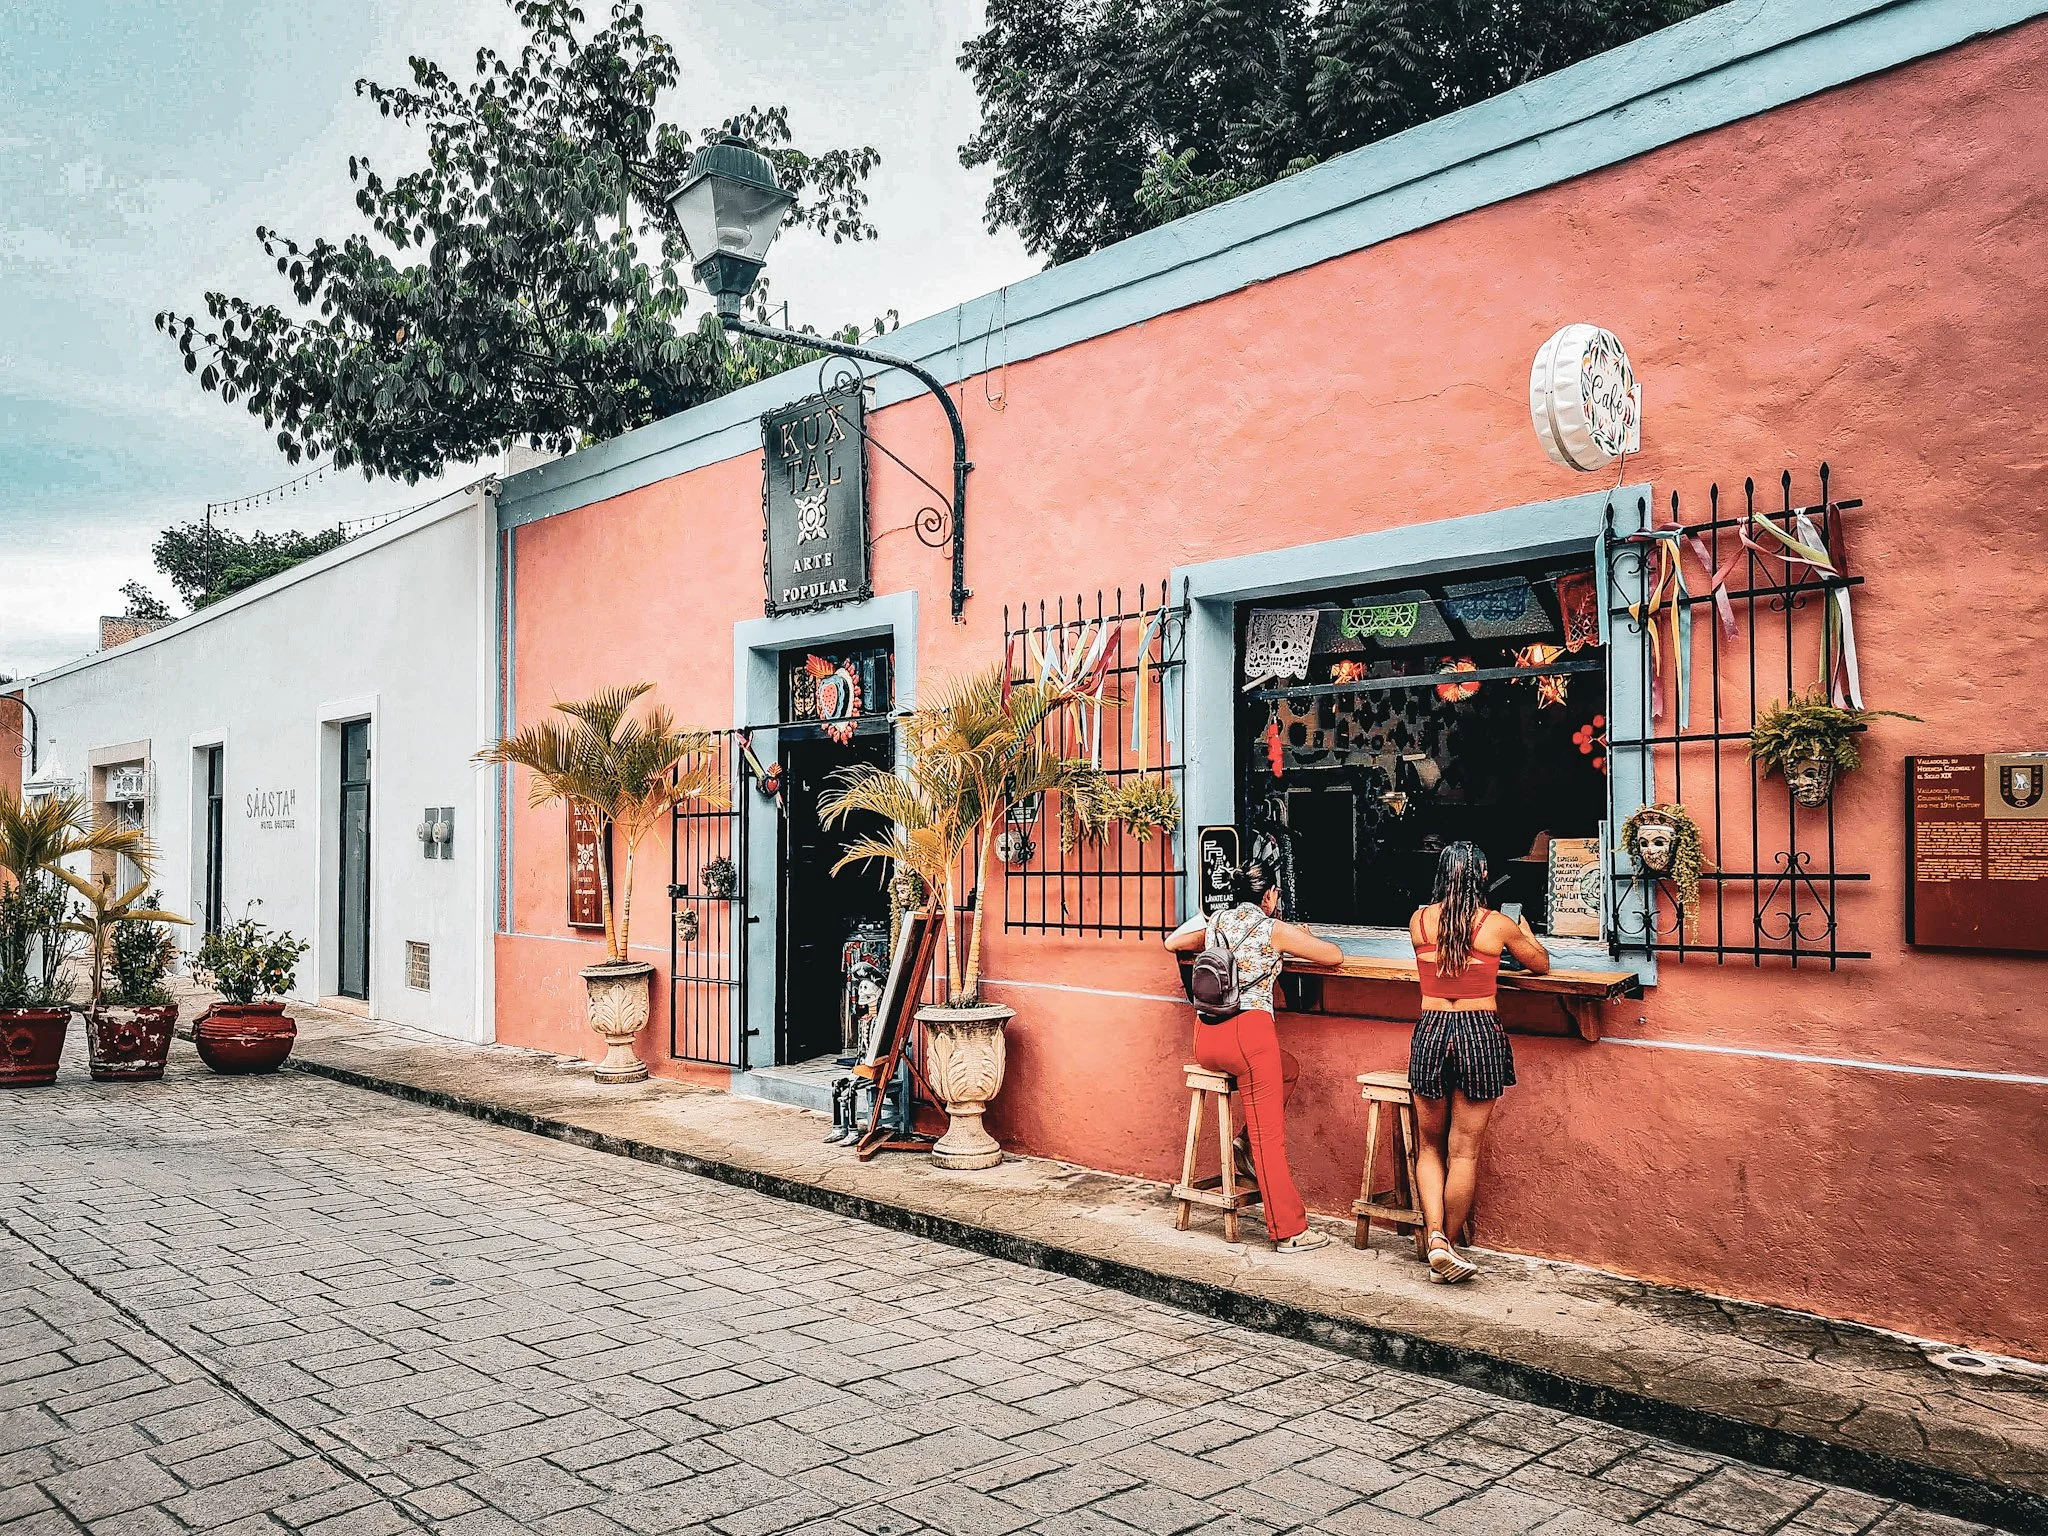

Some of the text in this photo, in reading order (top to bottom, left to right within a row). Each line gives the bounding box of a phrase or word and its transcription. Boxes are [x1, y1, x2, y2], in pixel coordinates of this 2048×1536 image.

[1591, 374, 1625, 423] Café
[779, 404, 846, 459] KUX
[786, 449, 843, 496] TAL
[792, 552, 834, 575] ARTE
[782, 578, 849, 603] POPULAR
[1210, 902, 1229, 910] MANOS
